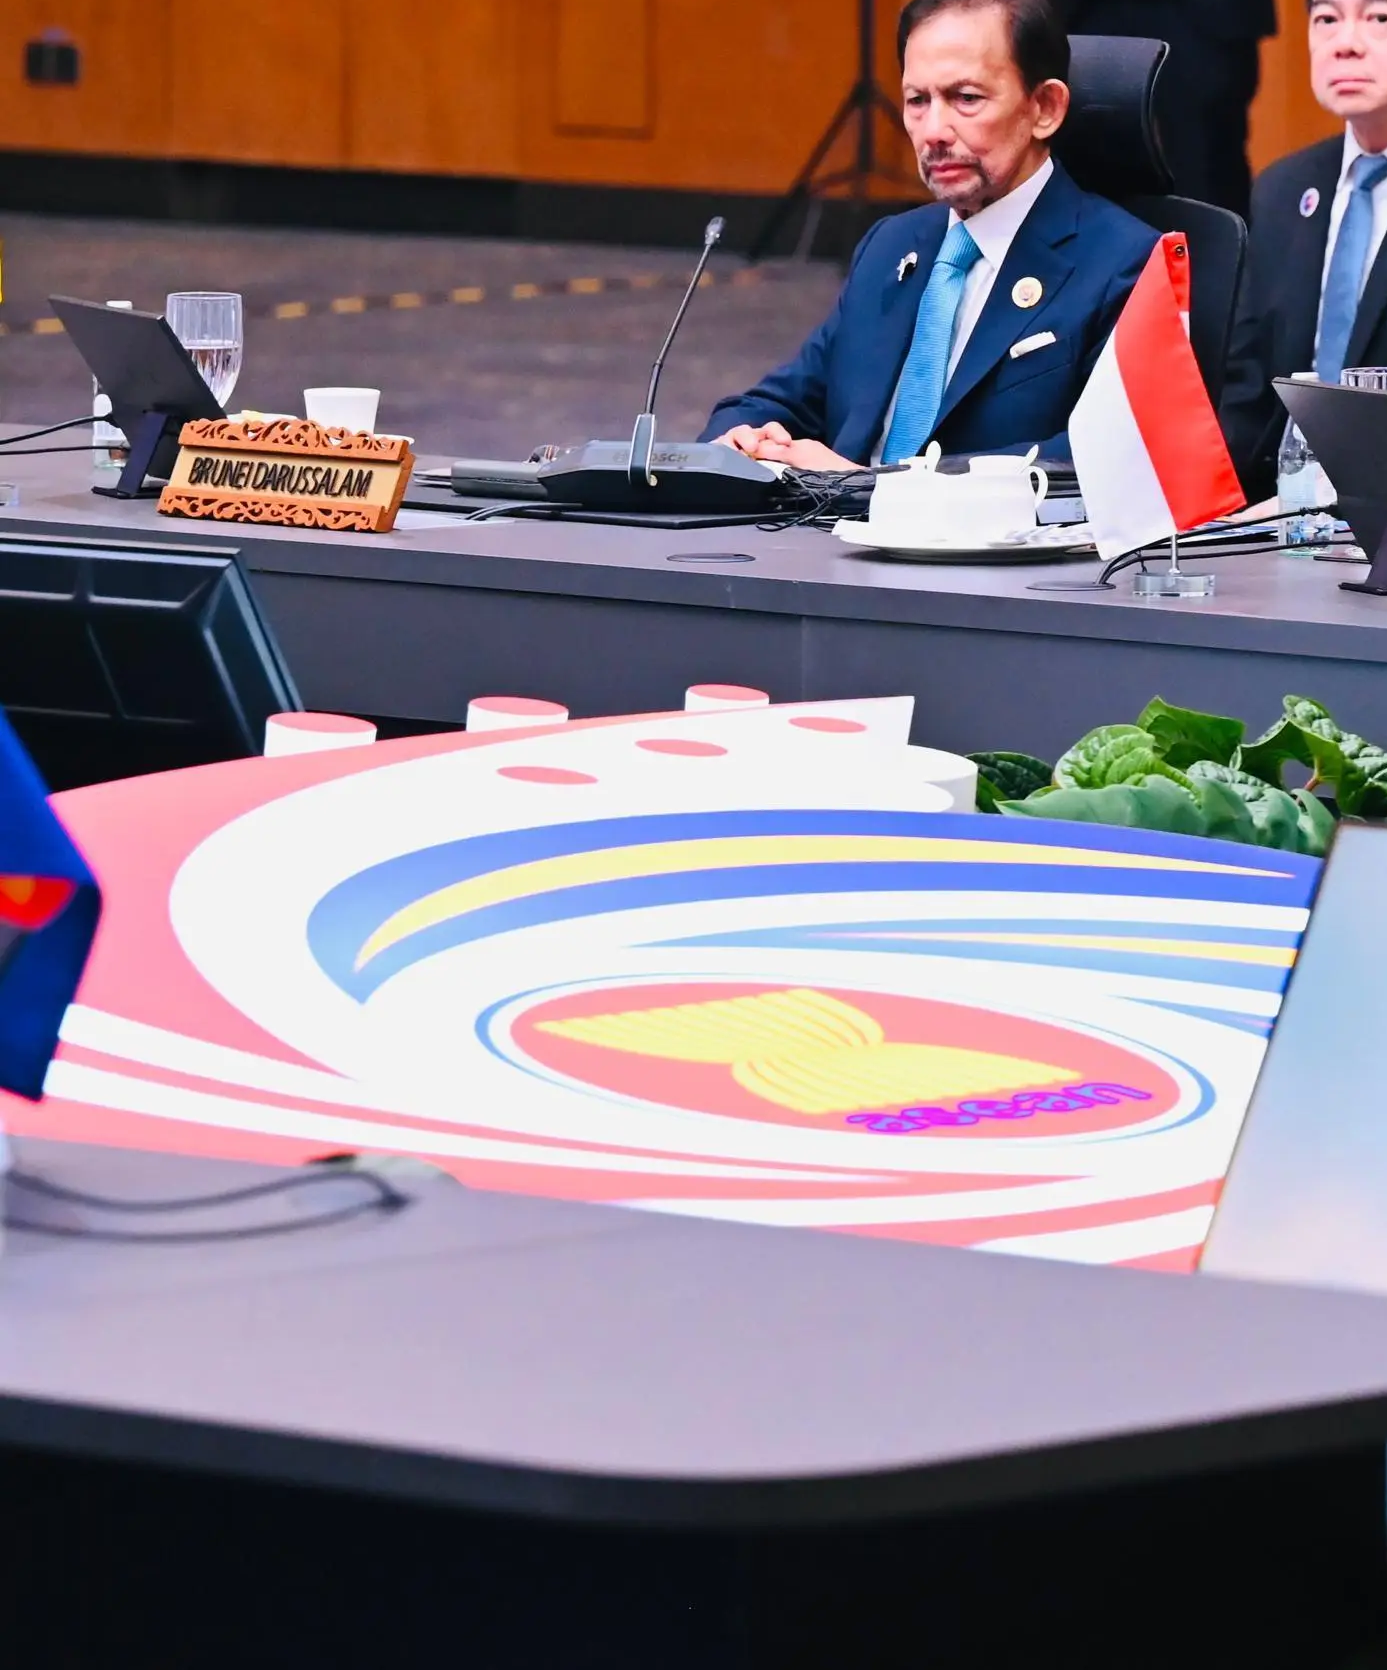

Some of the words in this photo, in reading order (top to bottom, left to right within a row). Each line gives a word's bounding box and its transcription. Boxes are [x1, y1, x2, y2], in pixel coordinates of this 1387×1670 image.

[188, 456, 252, 488] BRUNEI
[251, 461, 374, 499] DARUSSALAM
[845, 1082, 1153, 1134] asean
